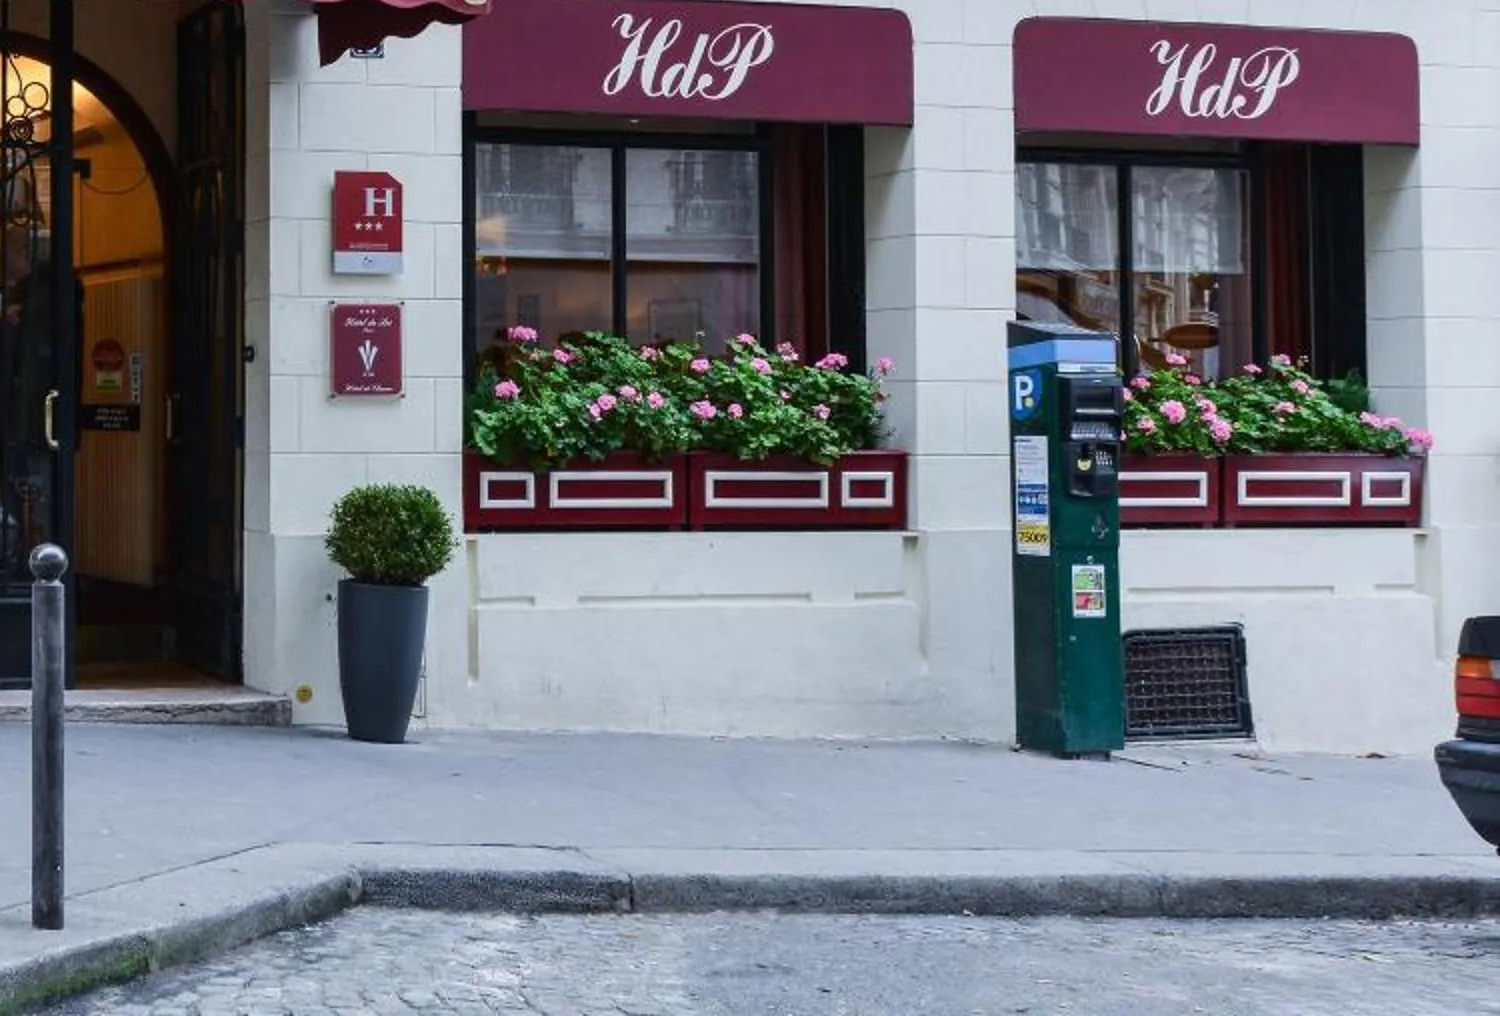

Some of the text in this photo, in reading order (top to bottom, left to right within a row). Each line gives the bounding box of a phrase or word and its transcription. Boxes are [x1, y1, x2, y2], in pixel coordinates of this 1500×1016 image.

[602, 13, 775, 100] HdP
[1145, 39, 1301, 119] HdP
[362, 187, 397, 217] H
[1015, 375, 1034, 411] P
